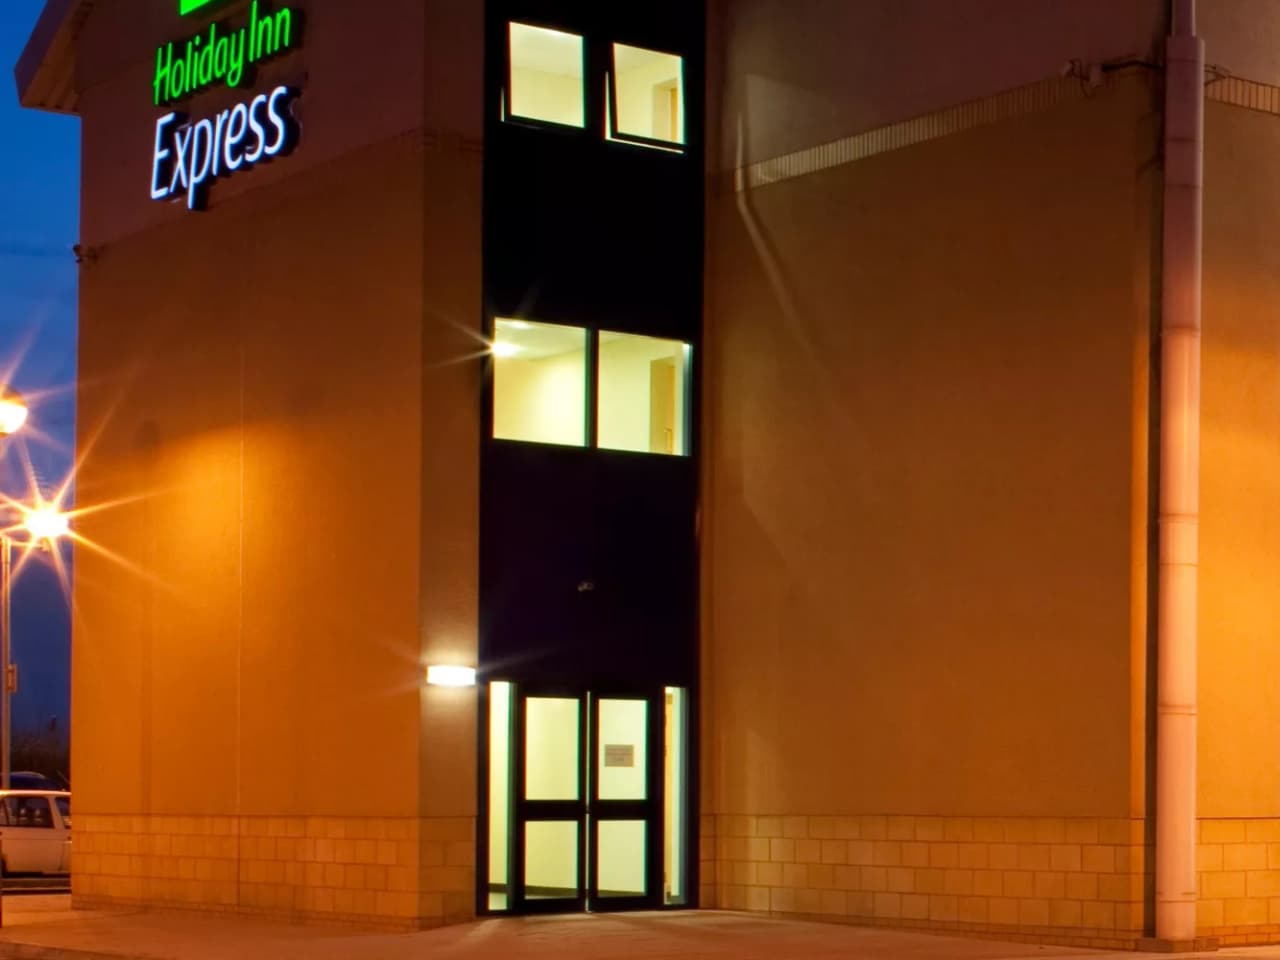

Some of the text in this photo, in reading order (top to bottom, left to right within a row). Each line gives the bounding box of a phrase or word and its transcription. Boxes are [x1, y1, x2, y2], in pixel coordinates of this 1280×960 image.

[154, 0, 291, 105] Holiday Inn
[150, 86, 287, 209] Express
